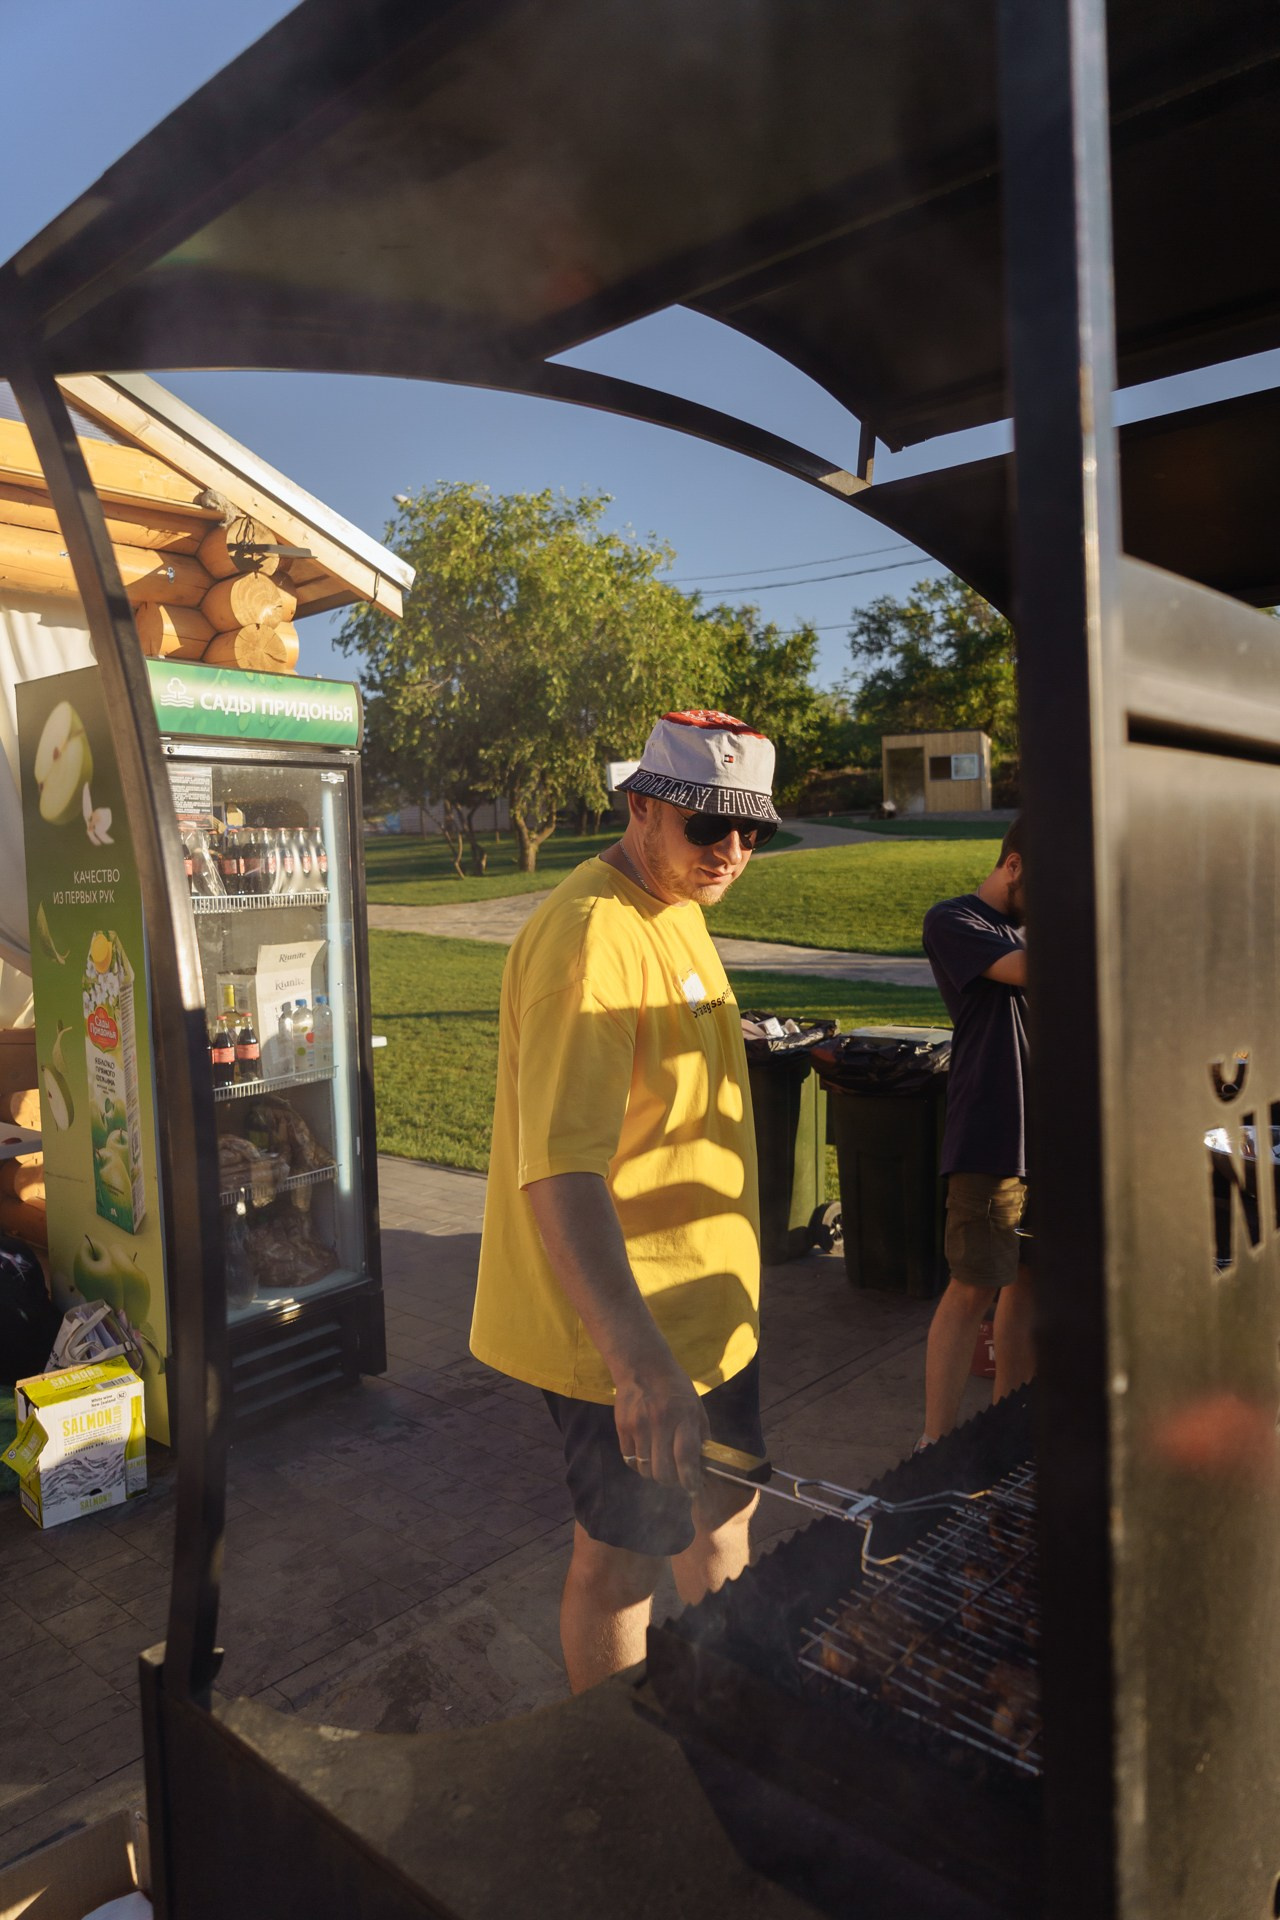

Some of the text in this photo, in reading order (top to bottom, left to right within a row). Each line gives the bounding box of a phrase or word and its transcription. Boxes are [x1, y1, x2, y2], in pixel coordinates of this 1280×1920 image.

[200, 692, 354, 723] САДЫ ПРИДОНЬЯ
[629, 771, 713, 810] TOMMY
[73, 868, 121, 884] КАЧЕСТВО
[53, 889, 115, 905] ИЗ ПЕРВЫХ РУК
[62, 1408, 113, 1438] SALMON
